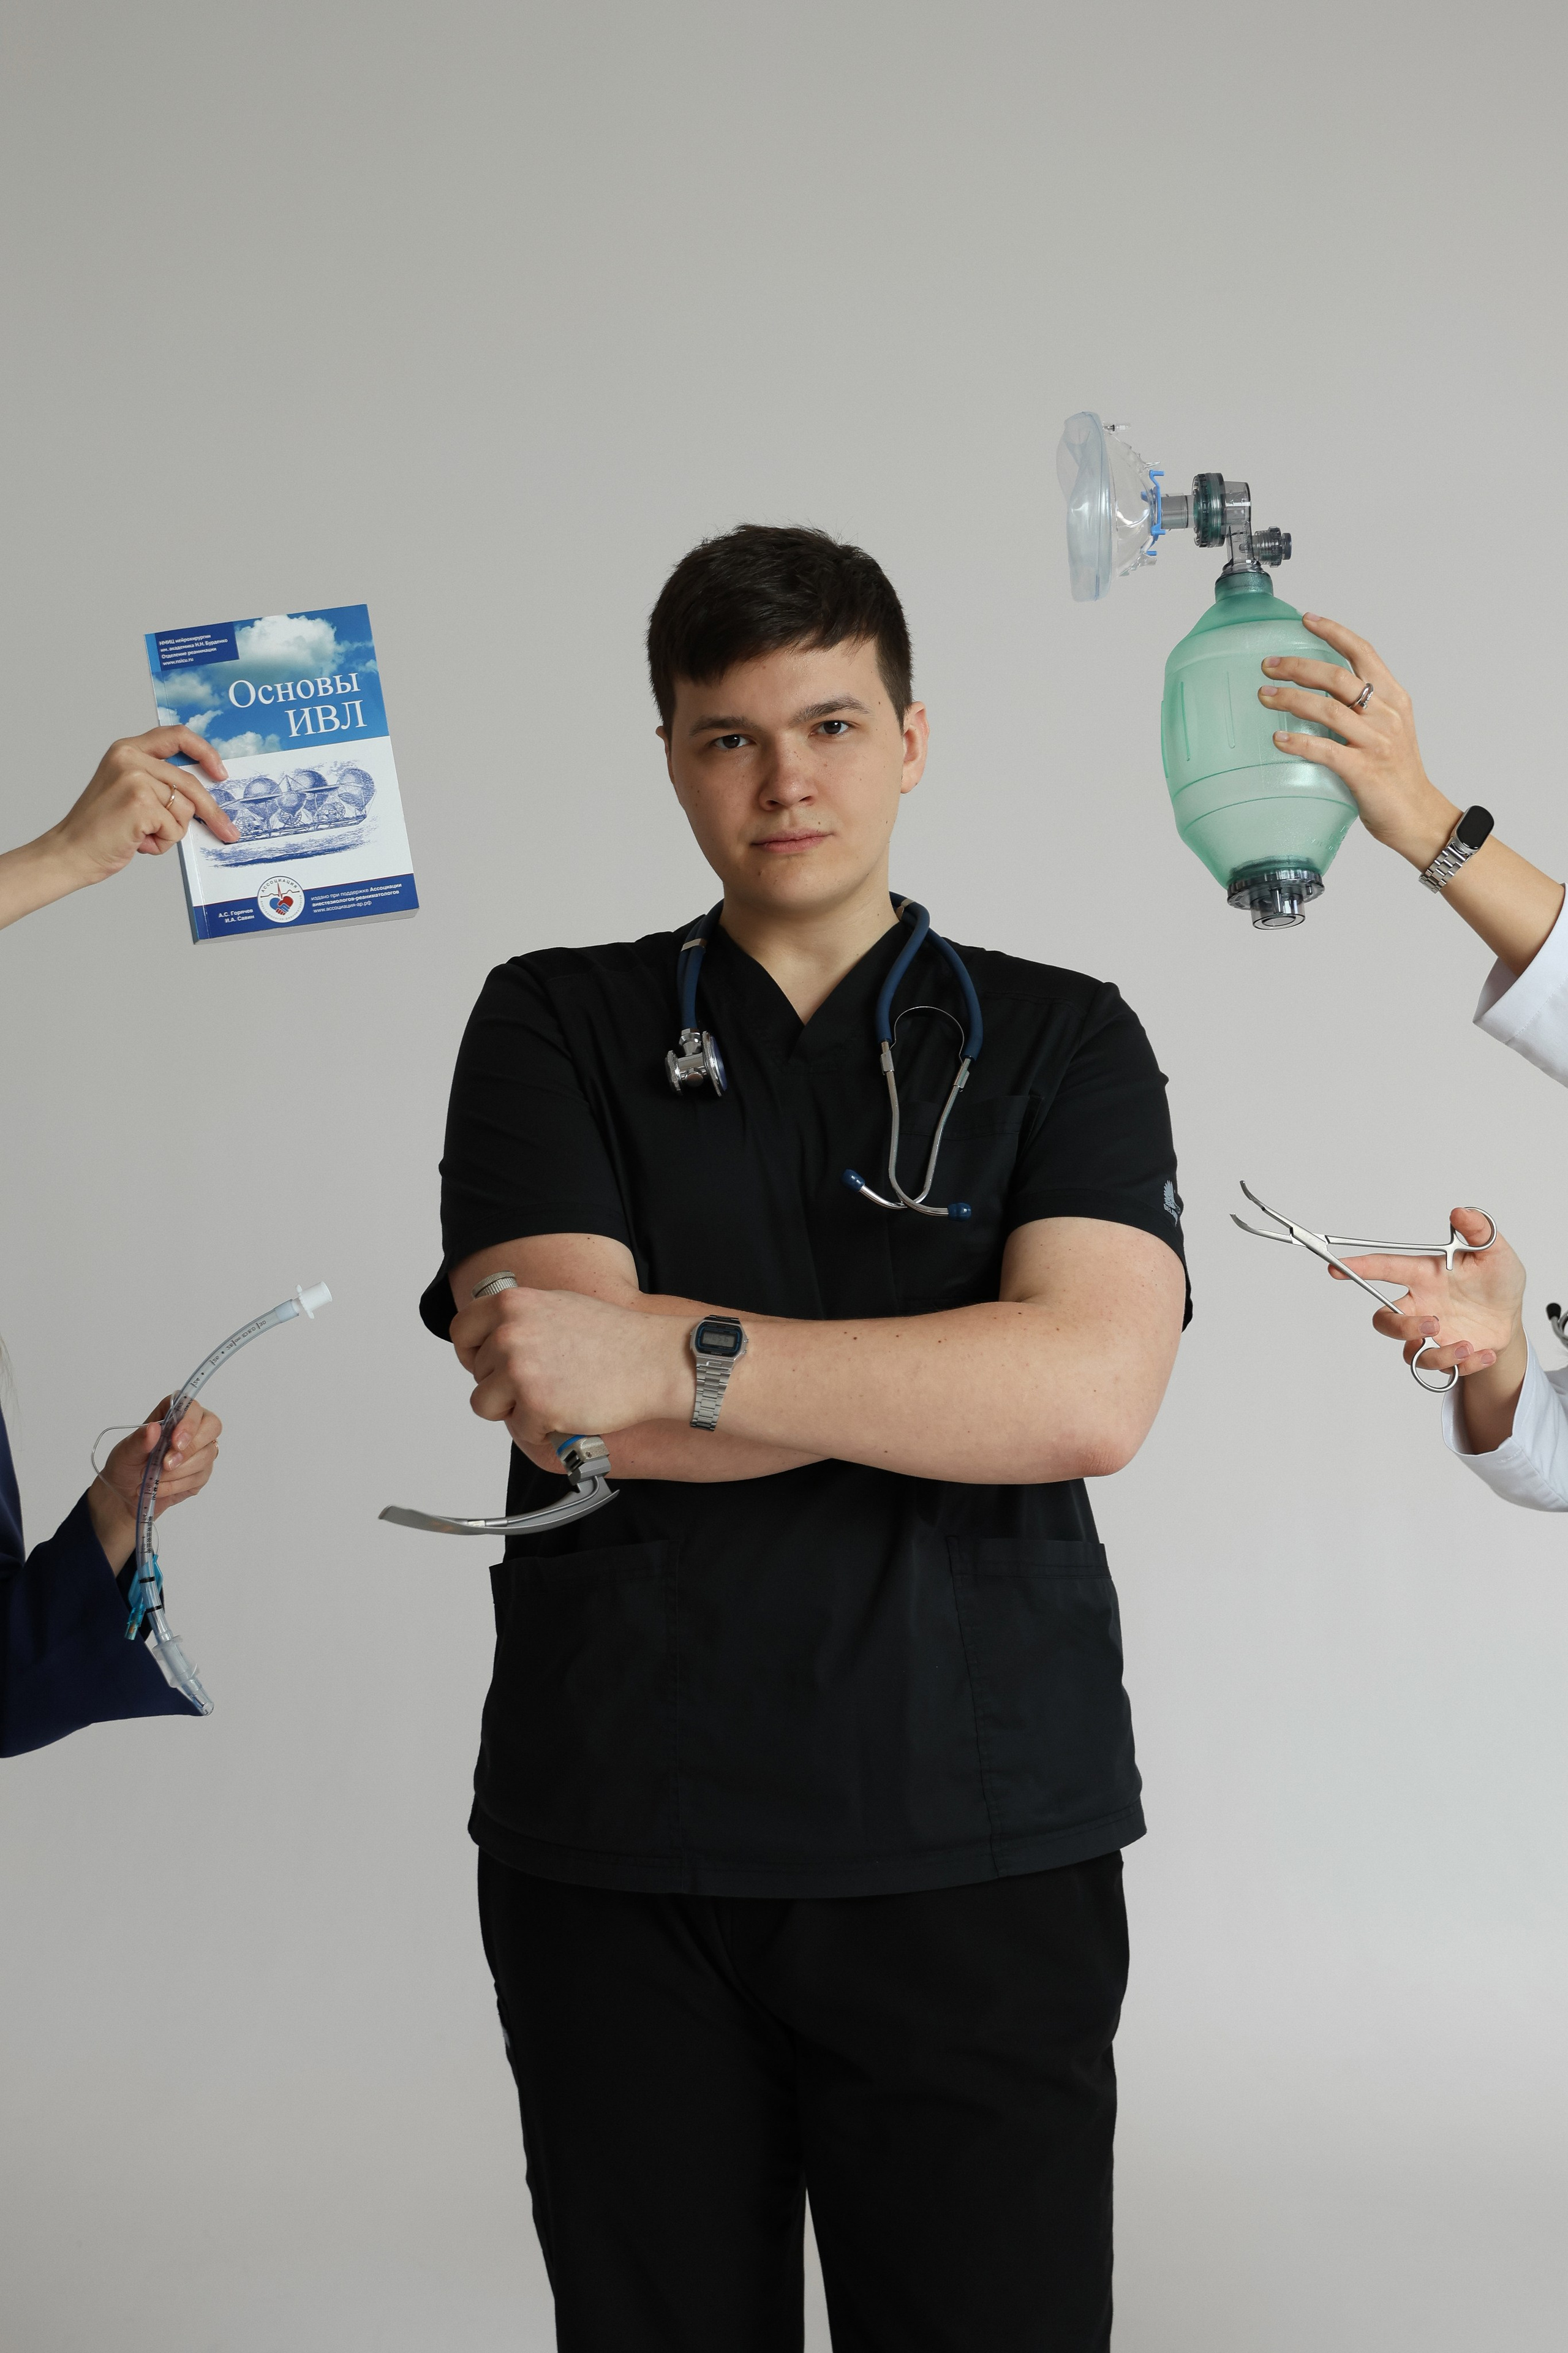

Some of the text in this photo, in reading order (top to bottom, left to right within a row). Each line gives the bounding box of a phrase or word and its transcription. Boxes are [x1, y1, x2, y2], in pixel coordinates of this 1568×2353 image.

[175, 634, 211, 643] нейрохирургии
[187, 648, 217, 656] реанимации
[162, 657, 194, 666] www.nsicu.ru
[228, 673, 361, 708] Основы
[284, 700, 368, 738] ИВЛ
[261, 878, 298, 893] АССОЦИАЦИЯ
[340, 888, 369, 897] поддержке
[369, 883, 402, 892] Ассоциации
[312, 889, 400, 907] анестезиологов-реаниматологов
[230, 908, 254, 916] Горячев
